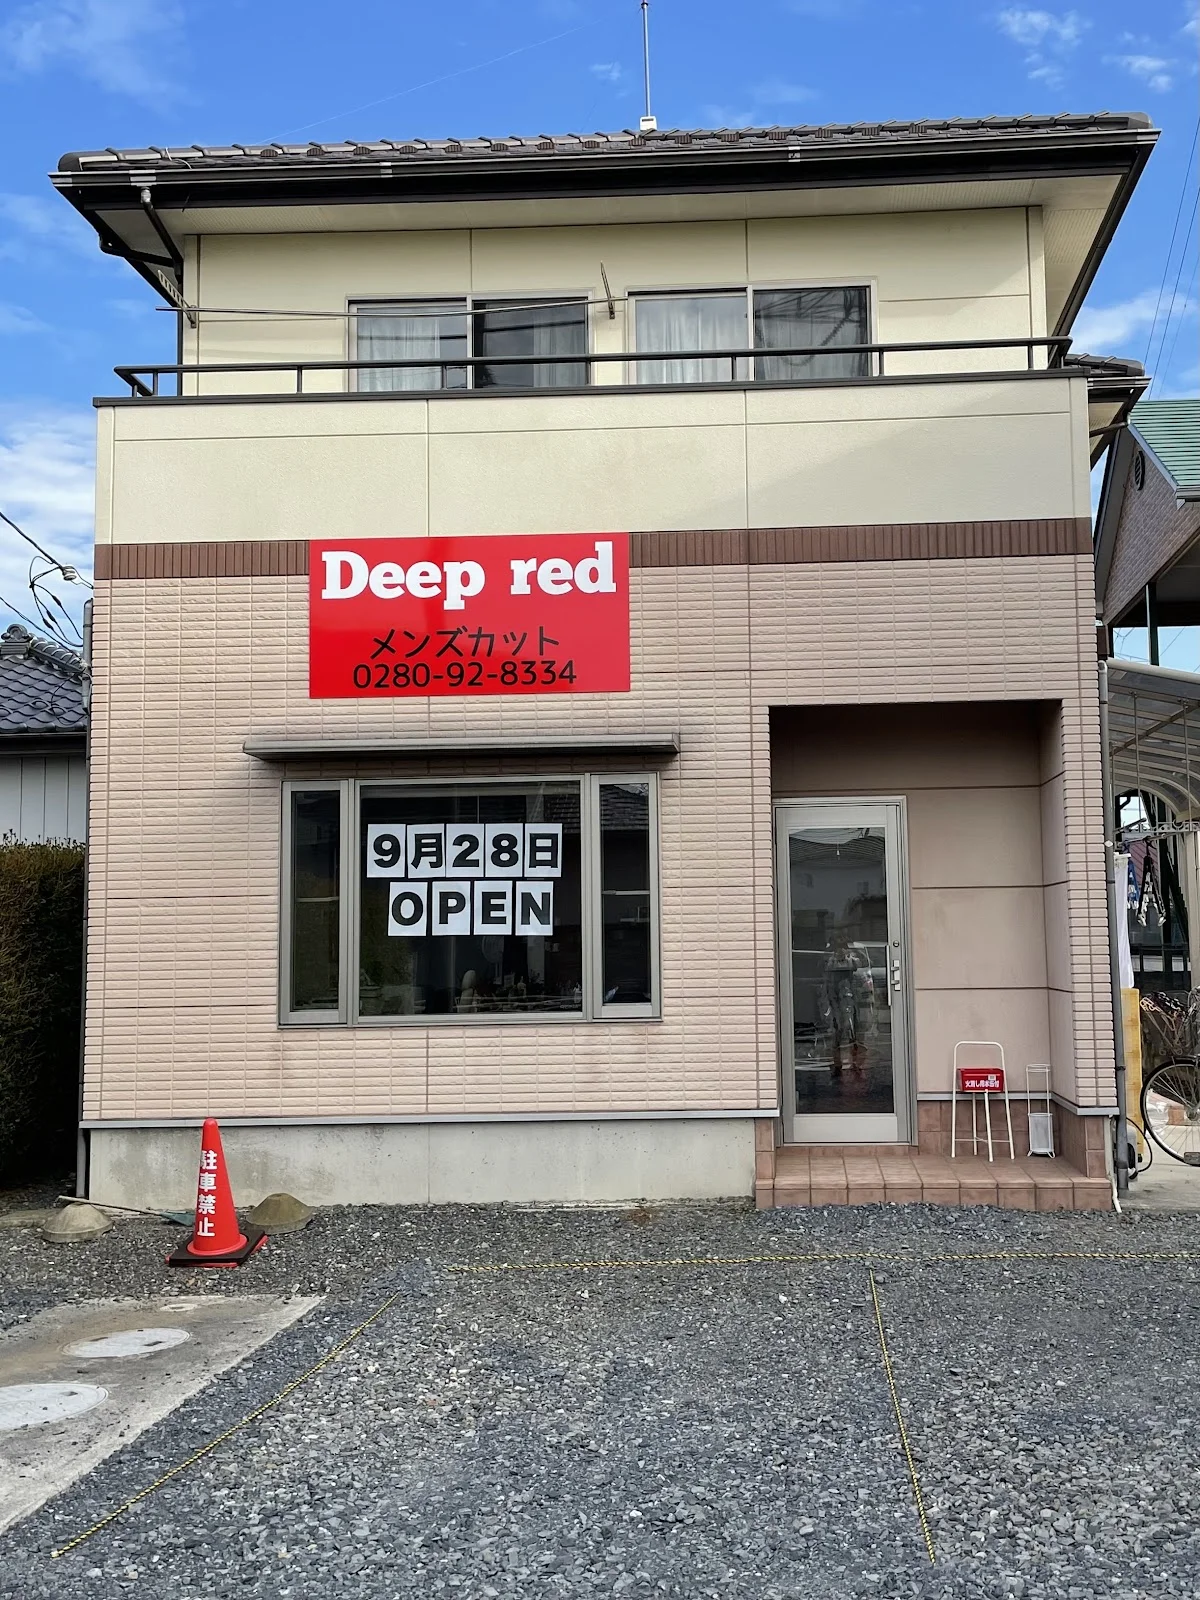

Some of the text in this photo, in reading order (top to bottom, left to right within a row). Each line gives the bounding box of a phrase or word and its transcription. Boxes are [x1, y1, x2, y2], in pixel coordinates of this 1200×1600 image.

[321, 541, 617, 610] Deep red
[370, 625, 560, 660] メンズカット
[353, 660, 577, 688] 0280-92-8334
[372, 832, 559, 870] 9月28日
[391, 891, 551, 926] OPEN
[197, 1149, 218, 1237] 駐車禁止
